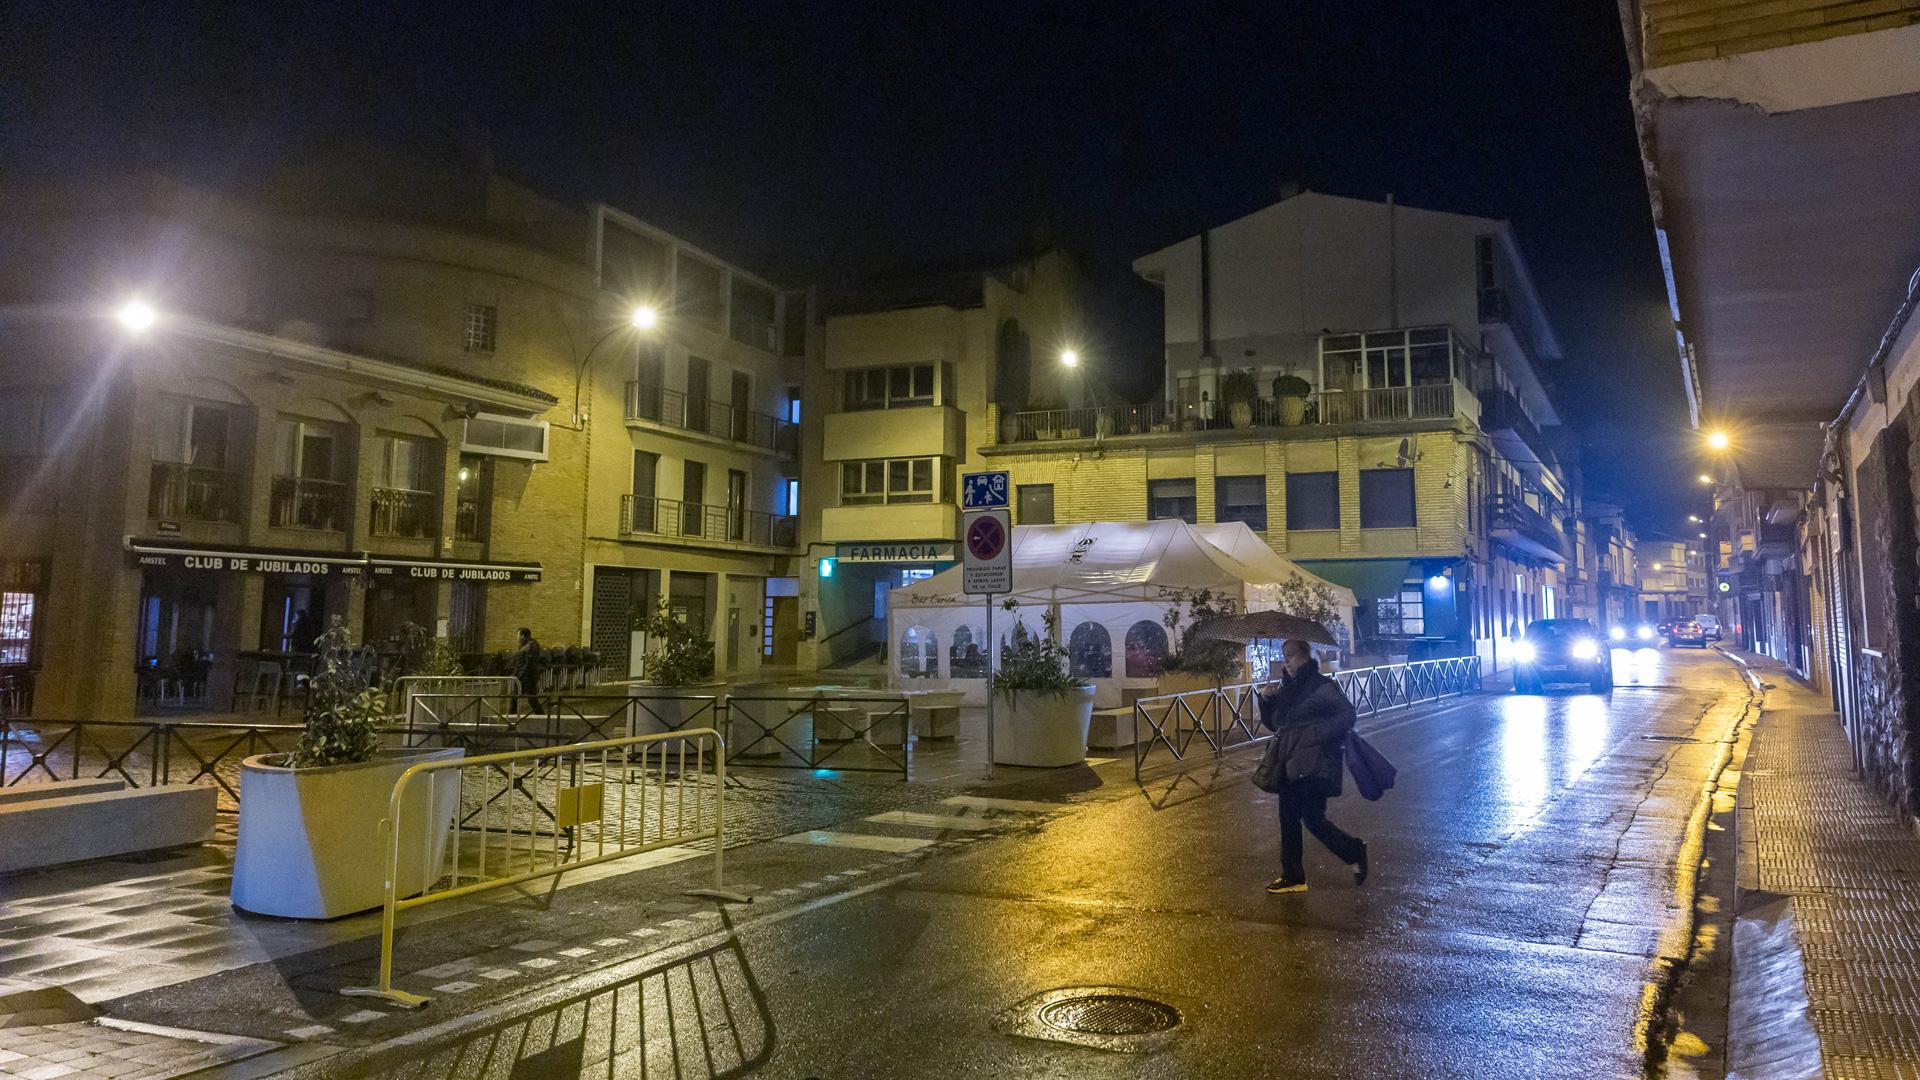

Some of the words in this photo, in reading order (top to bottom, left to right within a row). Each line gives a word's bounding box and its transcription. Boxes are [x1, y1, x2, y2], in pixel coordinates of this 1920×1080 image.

[851, 546, 938, 560] FARMACIA
[139, 557, 167, 566] AMSTEL
[184, 556, 223, 569] CLUB
[230, 559, 249, 571] DE
[256, 561, 329, 574] JUBILADOS
[342, 567, 362, 575] AMSTEL
[374, 567, 393, 575] AMSTEL
[410, 567, 438, 578] CLUB
[442, 568, 455, 579] DE
[459, 569, 511, 581] JUBILADOS
[1158, 586, 1176, 598] Bar
[911, 593, 928, 604] Bar
